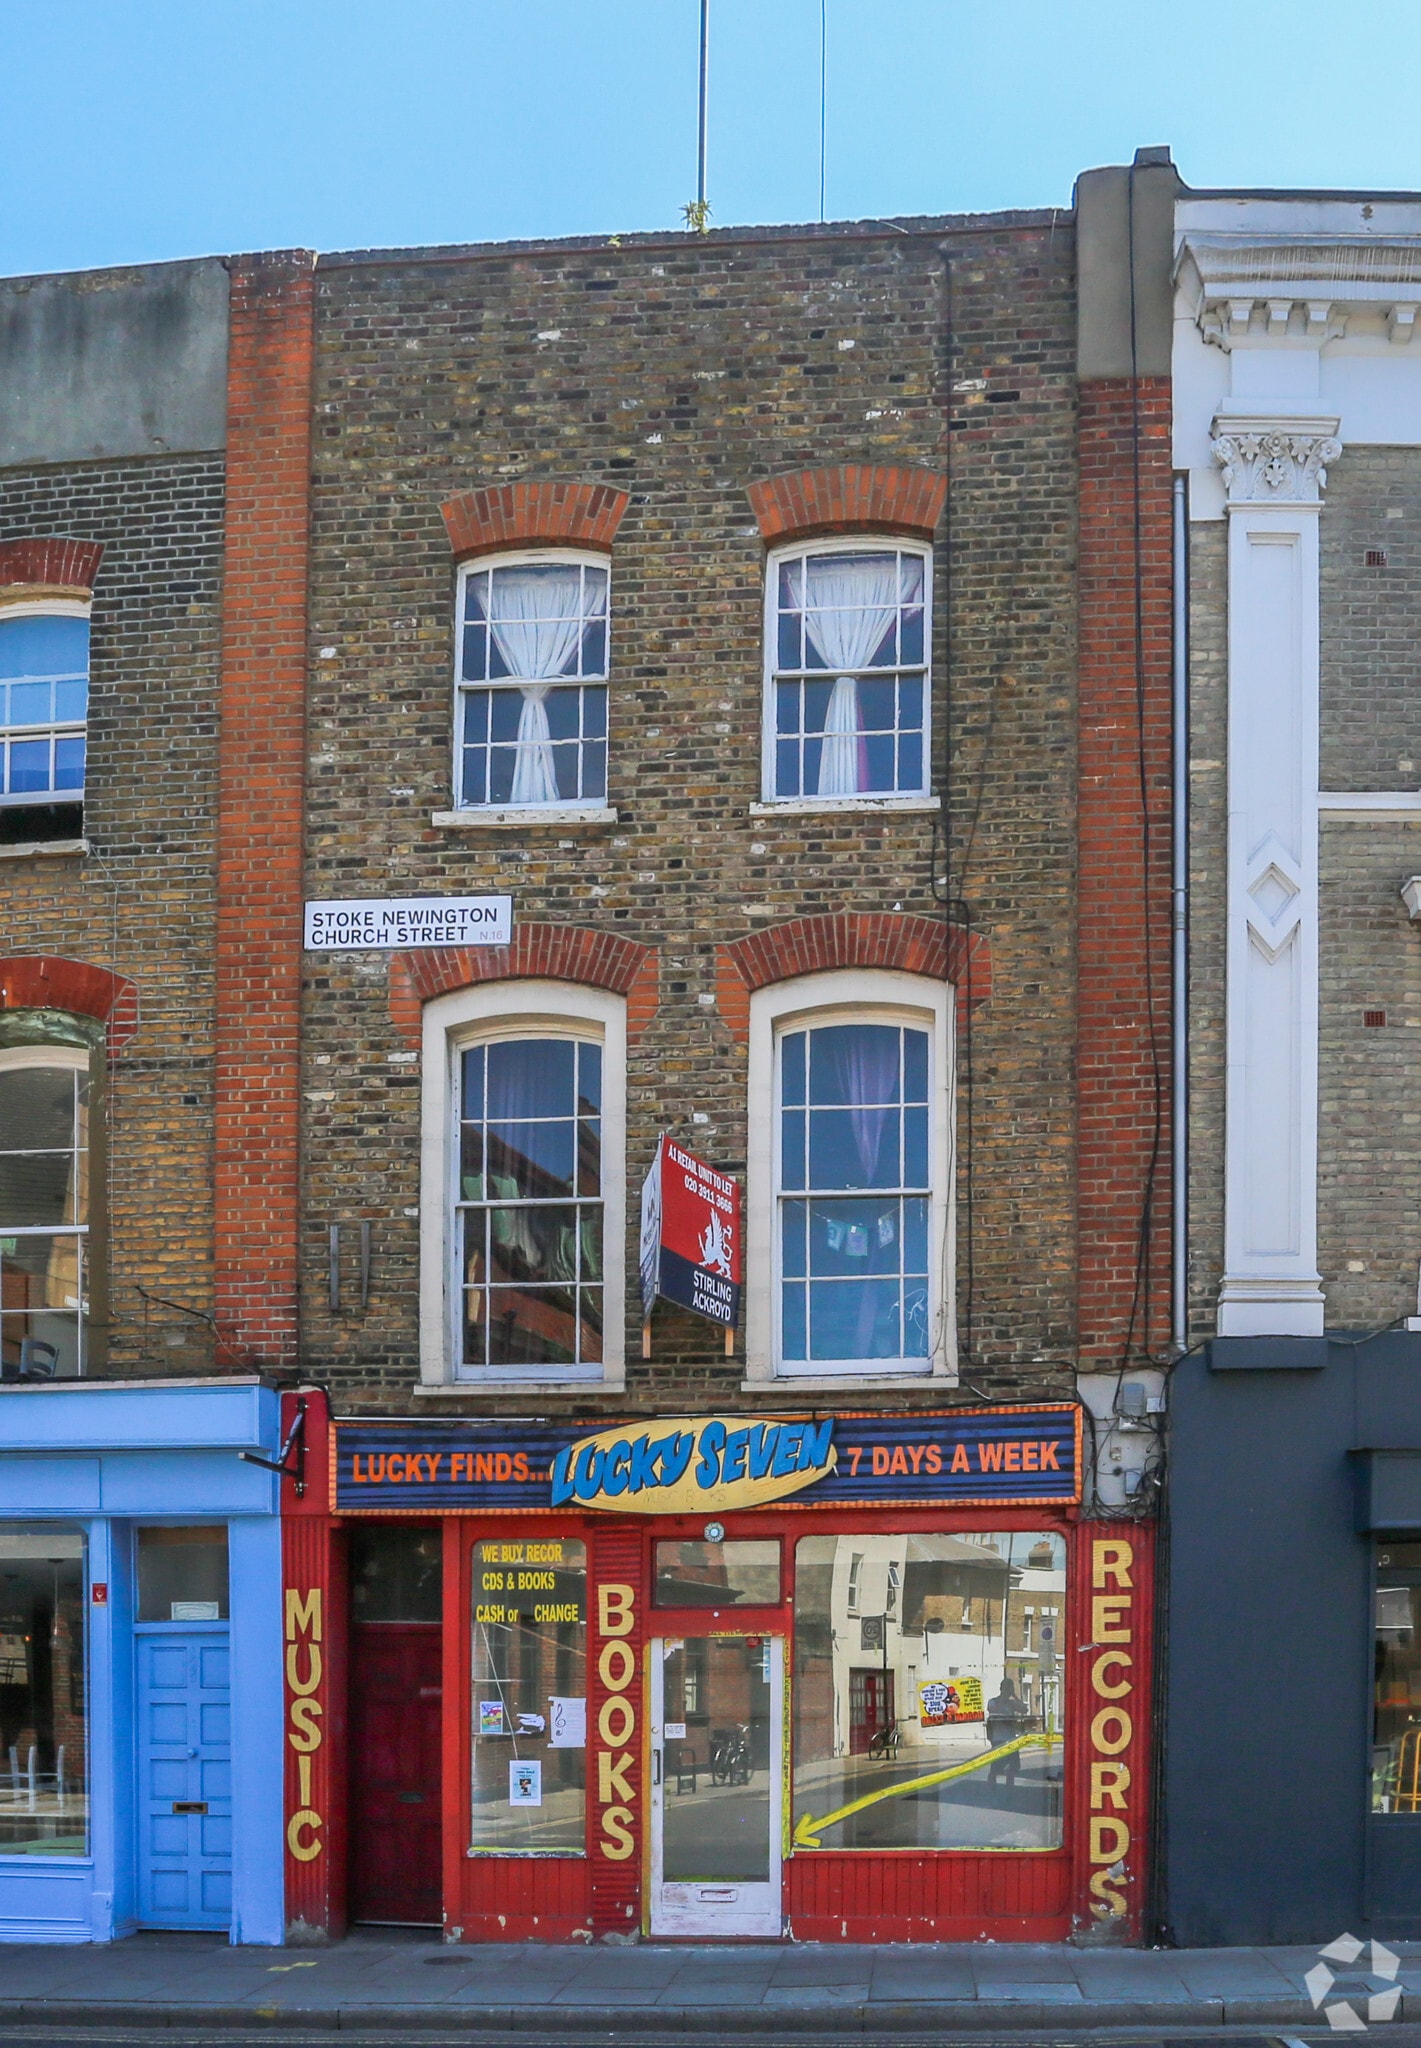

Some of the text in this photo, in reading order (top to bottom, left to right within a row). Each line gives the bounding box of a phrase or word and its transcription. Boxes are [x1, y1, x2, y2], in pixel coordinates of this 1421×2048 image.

[313, 908, 498, 927] STOKE NEWINGTON
[312, 926, 504, 945] CHURCH STREET N.16
[667, 1143, 733, 1197] A1 RETAIL UNIT TO LET
[684, 1174, 697, 1194] 020
[698, 1183, 715, 1205] 3911
[693, 1270, 732, 1302] STIRLING
[692, 1290, 731, 1321] ACKROYD
[353, 1453, 442, 1482] LUCKY
[550, 1417, 835, 1508] LUCKY SEVEN
[847, 1441, 1060, 1477] 7 DAYS A WEEK
[482, 1544, 563, 1563] WE BUY RECOR
[482, 1572, 555, 1590] CDS & BOOKS
[476, 1604, 579, 1623] CASH or CHANGE
[285, 1588, 323, 1862] MUSIC
[598, 1583, 637, 1861] BOOKS
[1088, 1538, 1135, 1920] RECORDS
